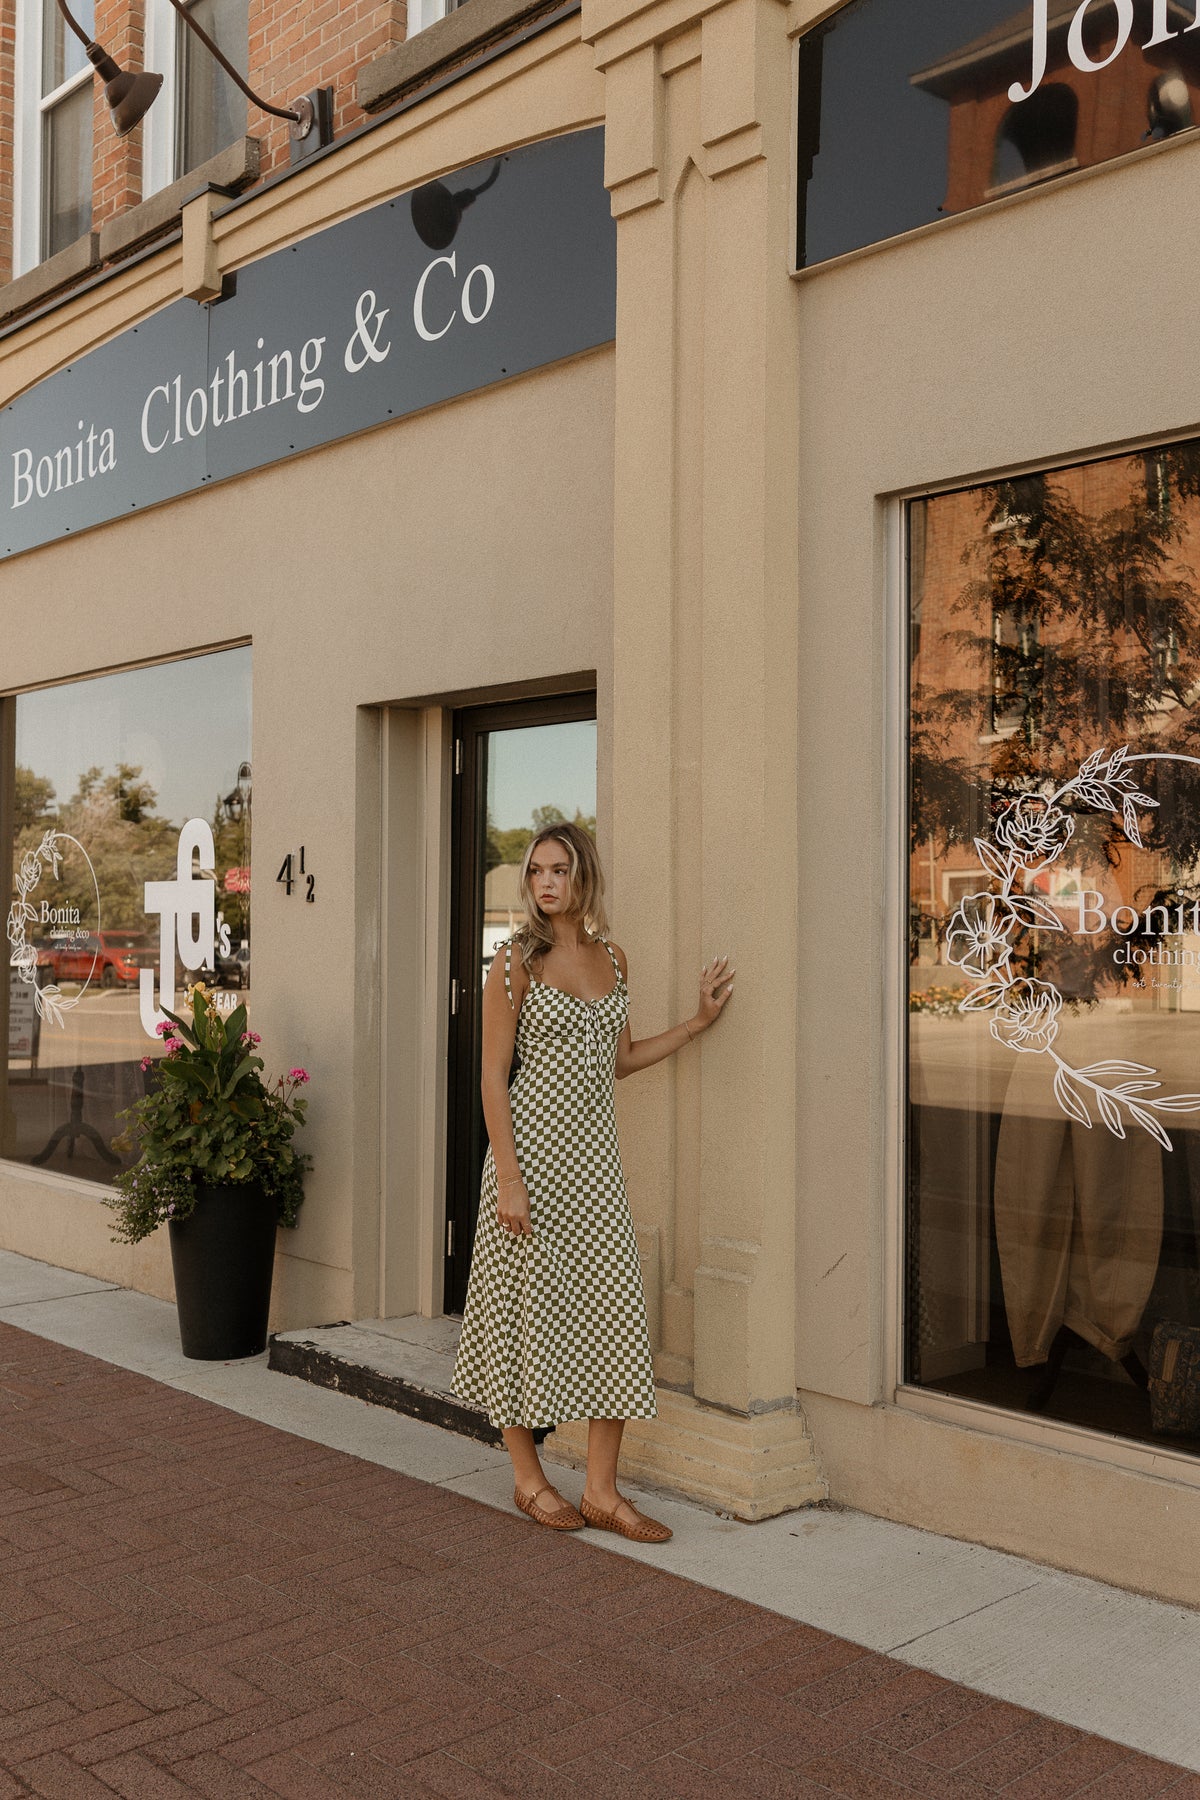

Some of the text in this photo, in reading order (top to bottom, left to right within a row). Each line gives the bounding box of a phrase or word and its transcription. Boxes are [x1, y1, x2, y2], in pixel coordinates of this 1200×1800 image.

[10, 250, 496, 510] Bonita Clothing & Co
[40, 899, 81, 924] Bonita
[50, 925, 75, 943] clothing
